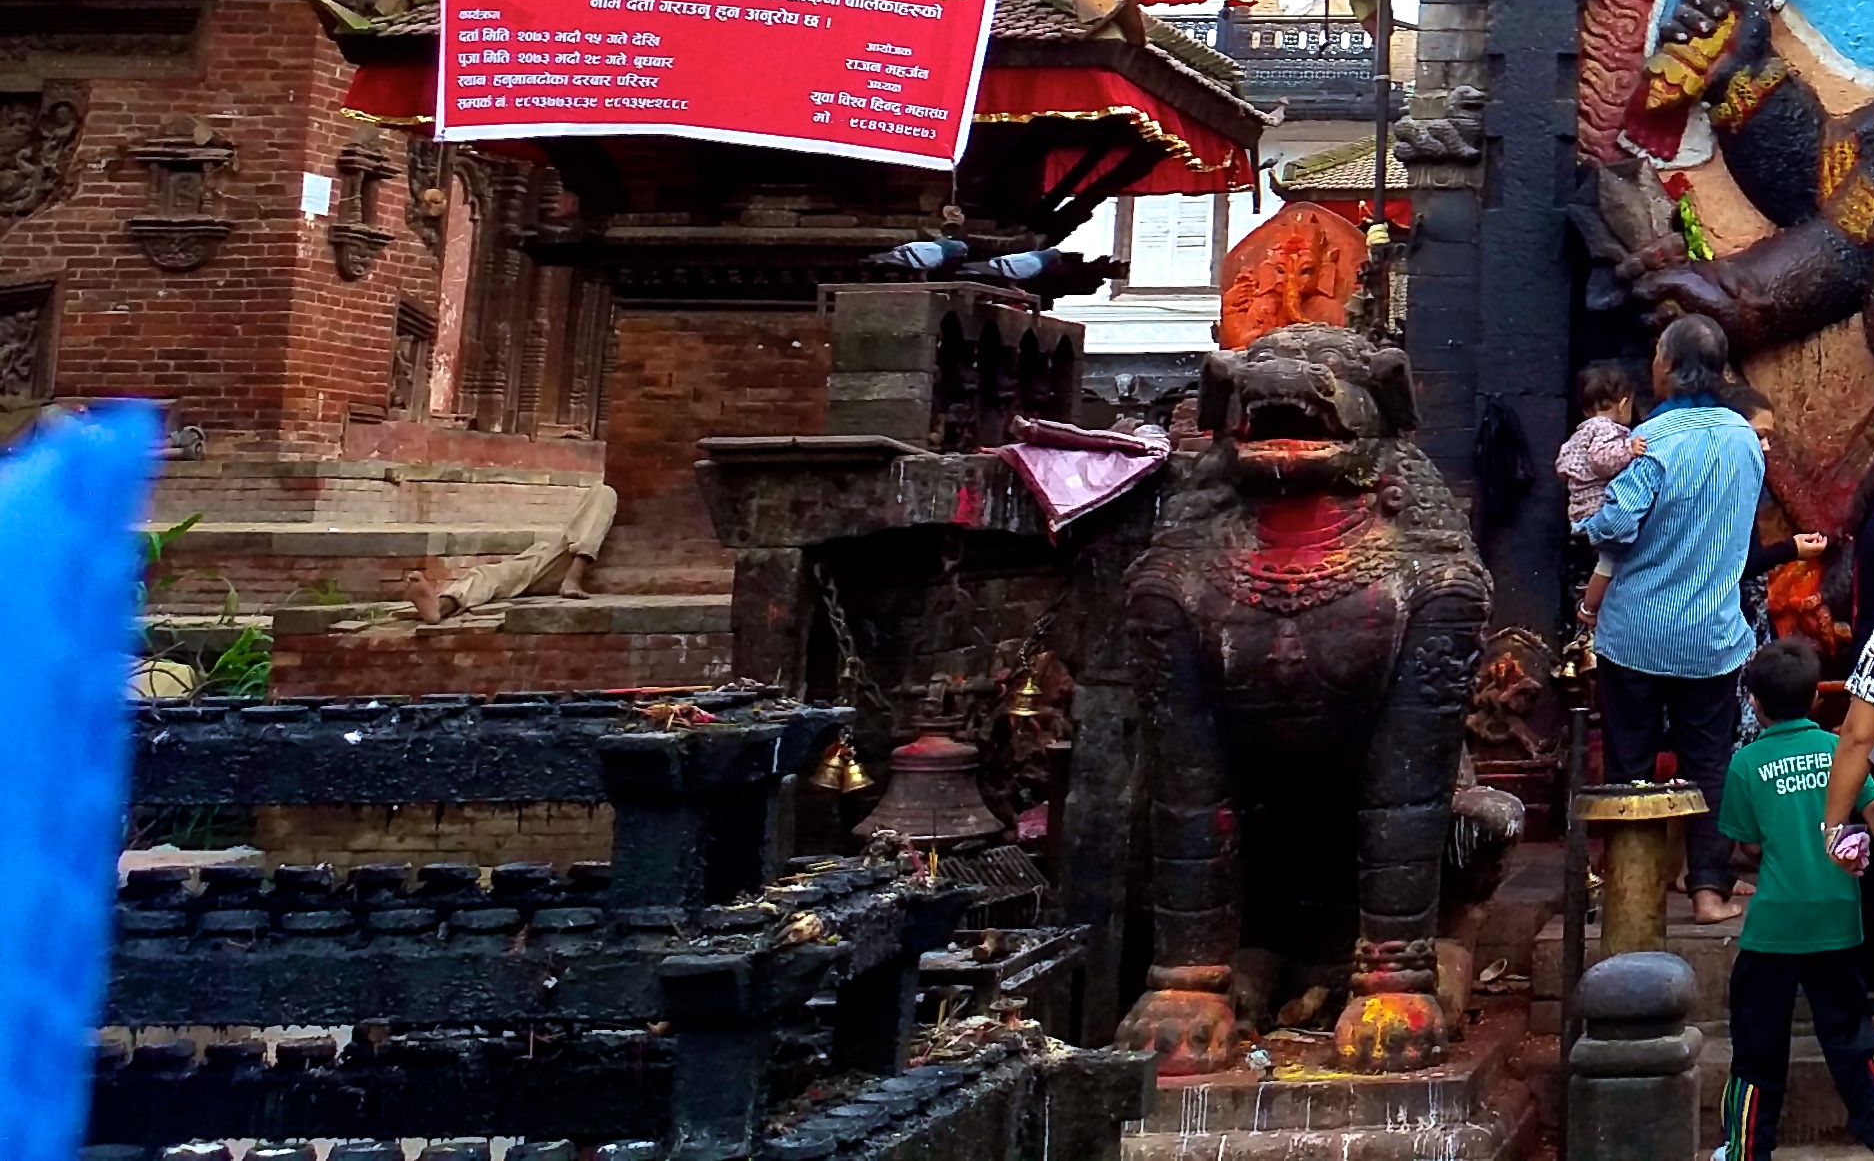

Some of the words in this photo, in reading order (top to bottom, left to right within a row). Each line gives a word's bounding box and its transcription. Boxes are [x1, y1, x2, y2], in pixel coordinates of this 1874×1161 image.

[658, 0, 712, 20] गराउनु
[714, 5, 742, 22] हुन
[744, 7, 801, 26] अनुरोध
[803, 14, 821, 28] छ
[458, 28, 479, 43] दर्ता
[516, 31, 551, 43] २०७३
[554, 29, 582, 44] भदौ
[584, 33, 602, 45] १५
[606, 31, 629, 45] गते
[631, 32, 661, 47] देखि
[865, 42, 913, 56] आयोजक
[457, 53, 481, 68] पुजा
[517, 52, 550, 65] २०७३
[554, 50, 581, 65] भदौ
[845, 58, 883, 73] राजन
[884, 64, 930, 80] महर्जन
[616, 72, 660, 88] परिसर
[809, 91, 835, 105] युवा
[1775, 770, 1831, 795] SCHOO
